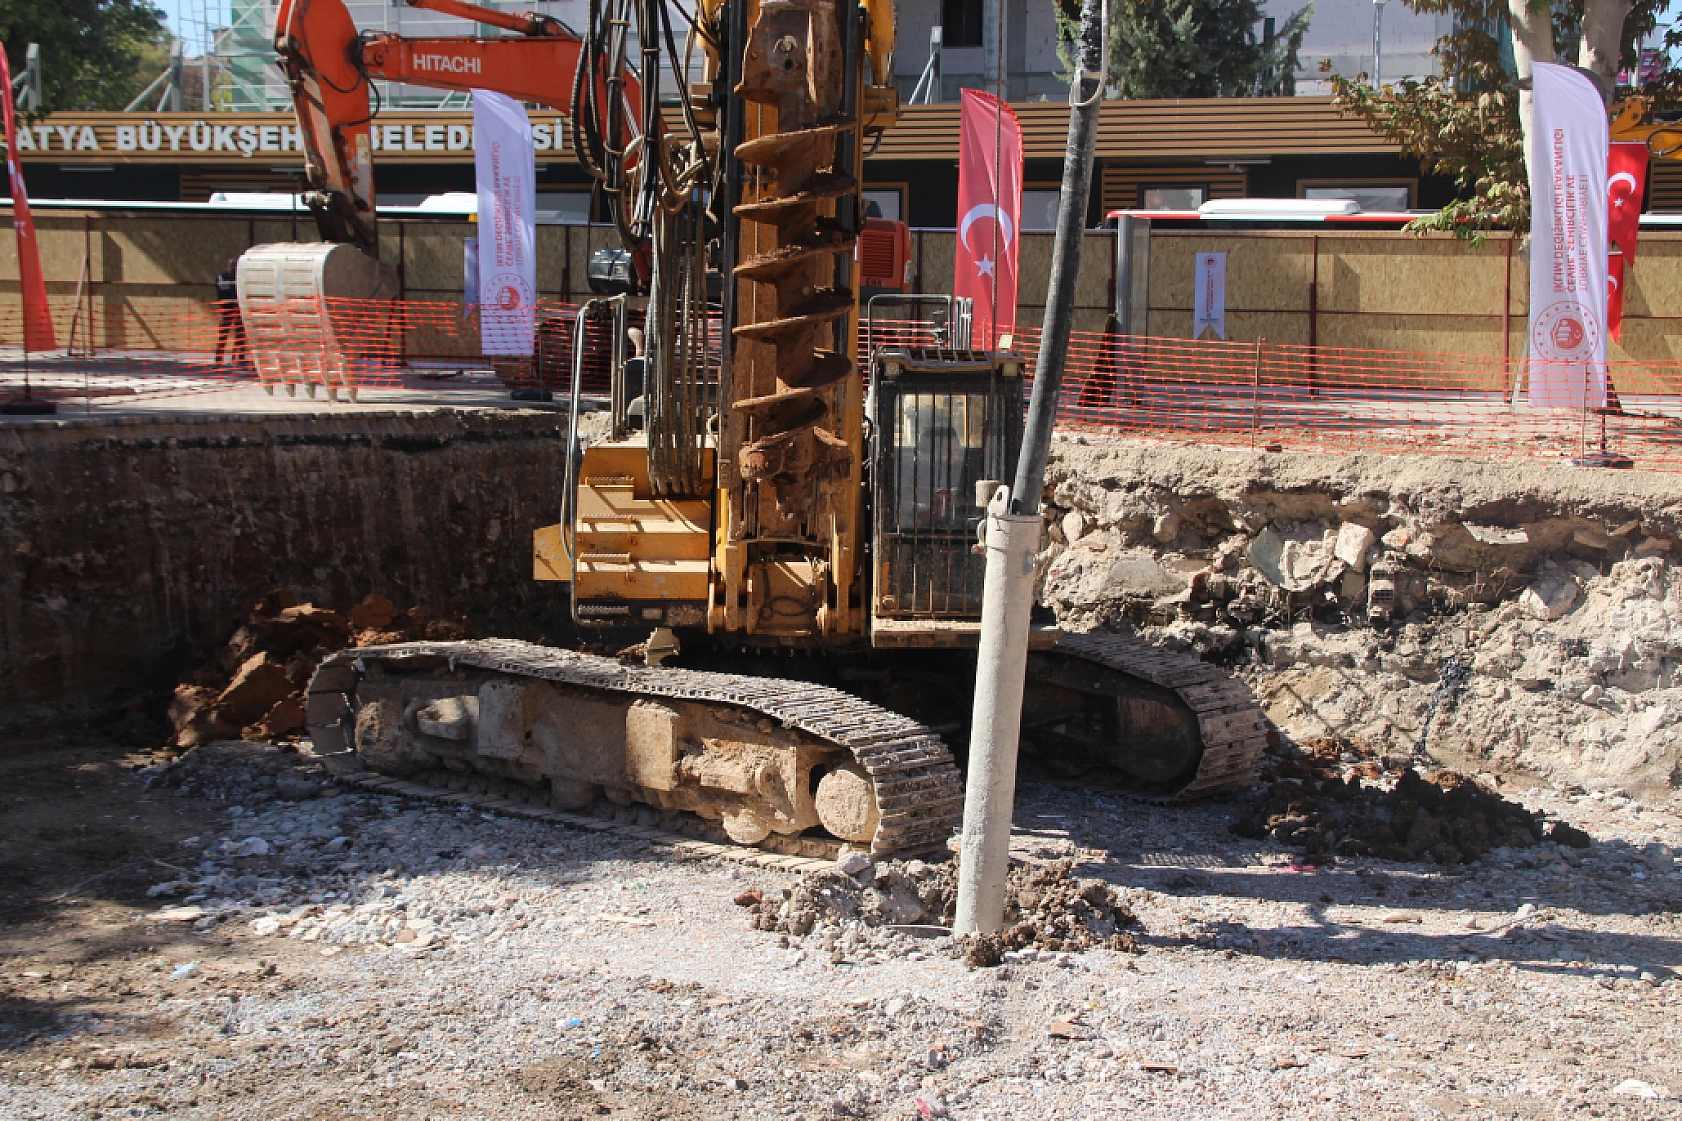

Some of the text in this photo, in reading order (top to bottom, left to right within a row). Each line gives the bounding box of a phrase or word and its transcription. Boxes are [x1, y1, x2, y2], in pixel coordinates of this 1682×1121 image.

[413, 53, 481, 74] HITACHI
[0, 125, 99, 151] ATYA
[116, 120, 304, 157] BÜYÜKŞEH
